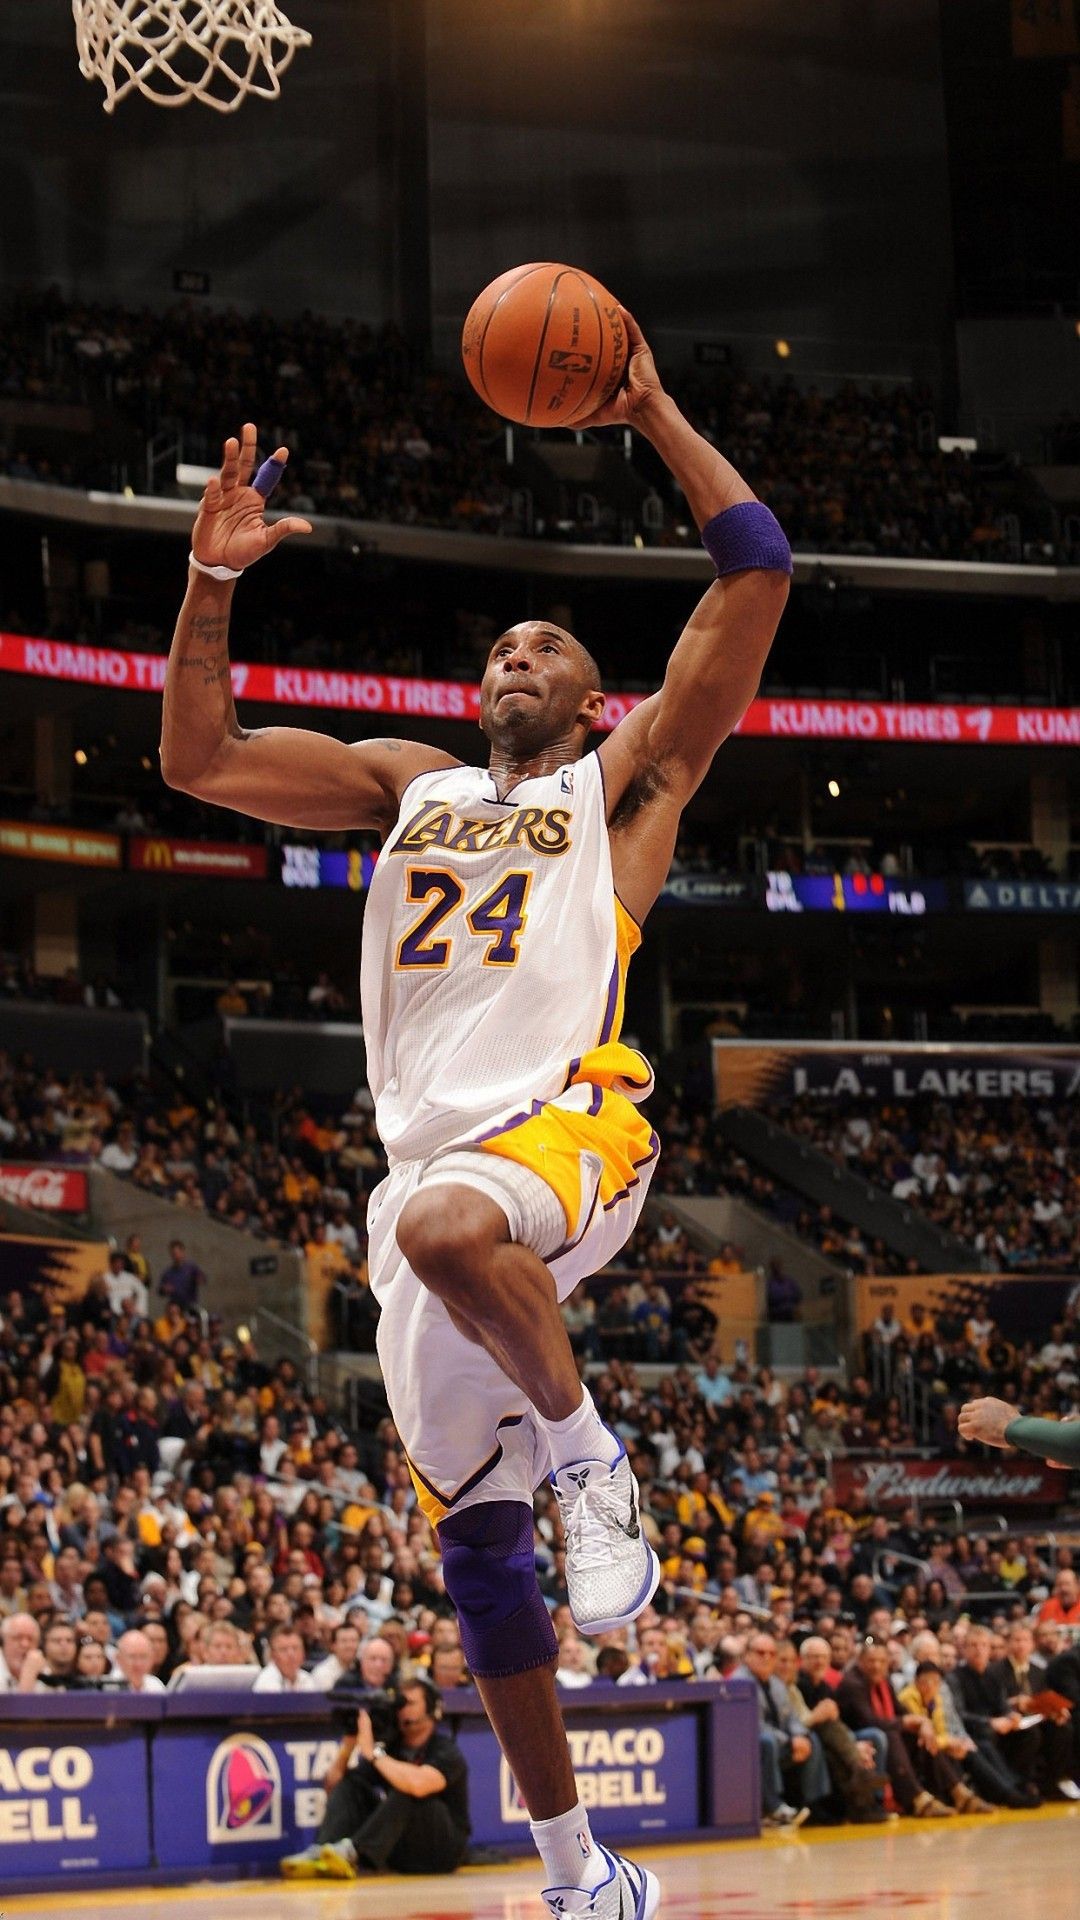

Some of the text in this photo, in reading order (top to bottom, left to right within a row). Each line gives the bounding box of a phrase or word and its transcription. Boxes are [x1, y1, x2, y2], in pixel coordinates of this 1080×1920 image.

[24, 641, 127, 685] KUMHO
[273, 669, 383, 709] KUMHO
[388, 679, 464, 716] TIRES
[769, 704, 960, 739] KUMHO TIRES
[389, 799, 573, 858] LAKERS
[393, 863, 535, 973] 24
[793, 1067, 876, 1096] L.A.
[893, 1068, 1055, 1098] LAKERS
[856, 1460, 1043, 1498] Budweiser
[283, 1740, 360, 1781] TA
[566, 1727, 665, 1767] TACO
[575, 1769, 666, 1809] BELL
